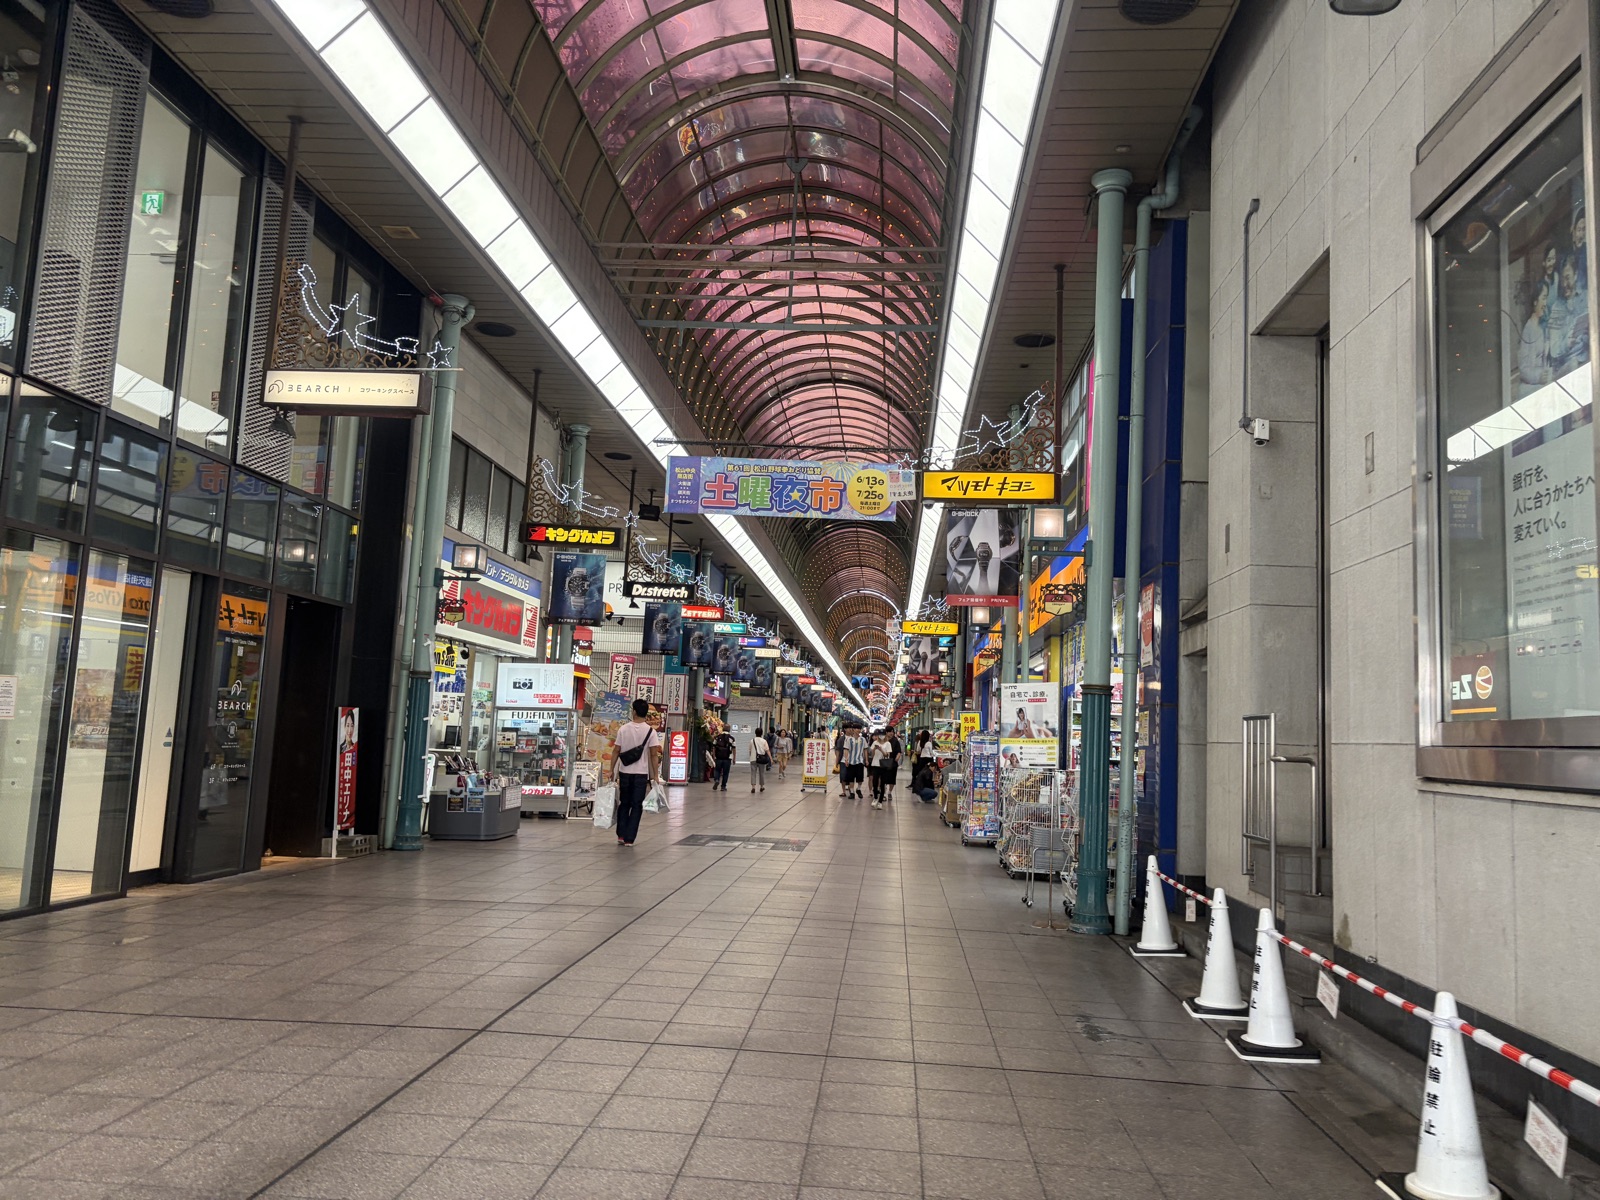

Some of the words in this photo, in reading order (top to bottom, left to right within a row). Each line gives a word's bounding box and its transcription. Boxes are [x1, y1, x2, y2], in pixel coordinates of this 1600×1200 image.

[287, 384, 340, 393] BEARCH
[360, 387, 415, 395] コワーキングスペース
[727, 463, 750, 473] 第61回
[1512, 464, 1549, 493] 銀行を、
[702, 472, 845, 512] 土曜夜市
[941, 475, 1036, 497] マツモトキヨシ
[1513, 474, 1596, 518] 人に合うかたちへ
[545, 527, 616, 545] キングカメラ
[1513, 511, 1567, 544] 変えていく。
[632, 584, 689, 598] Dr.stretch
[463, 587, 523, 637] キングカメラ
[620, 664, 631, 688] 英会話
[217, 700, 252, 711] BEARCH
[511, 711, 555, 719] FUJIFILM
[806, 741, 815, 774] 走行禁止
[342, 752, 353, 822] 田中エリナ
